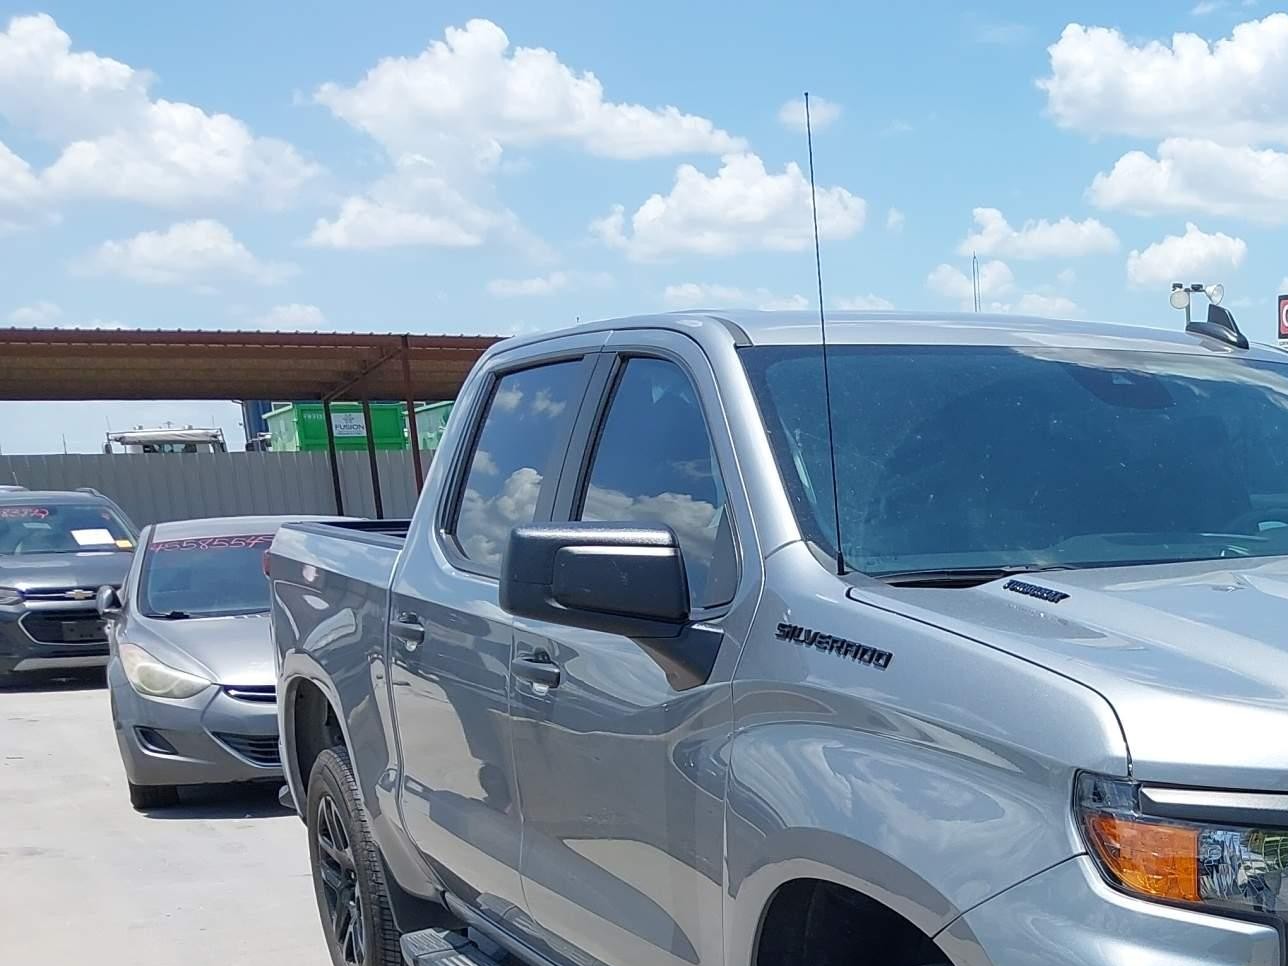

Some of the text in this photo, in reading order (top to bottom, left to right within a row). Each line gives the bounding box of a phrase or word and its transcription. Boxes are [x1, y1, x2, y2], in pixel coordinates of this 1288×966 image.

[334, 423, 365, 432] FUSION
[150, 533, 276, 553] 4558554
[775, 622, 894, 670] SILVERADO
